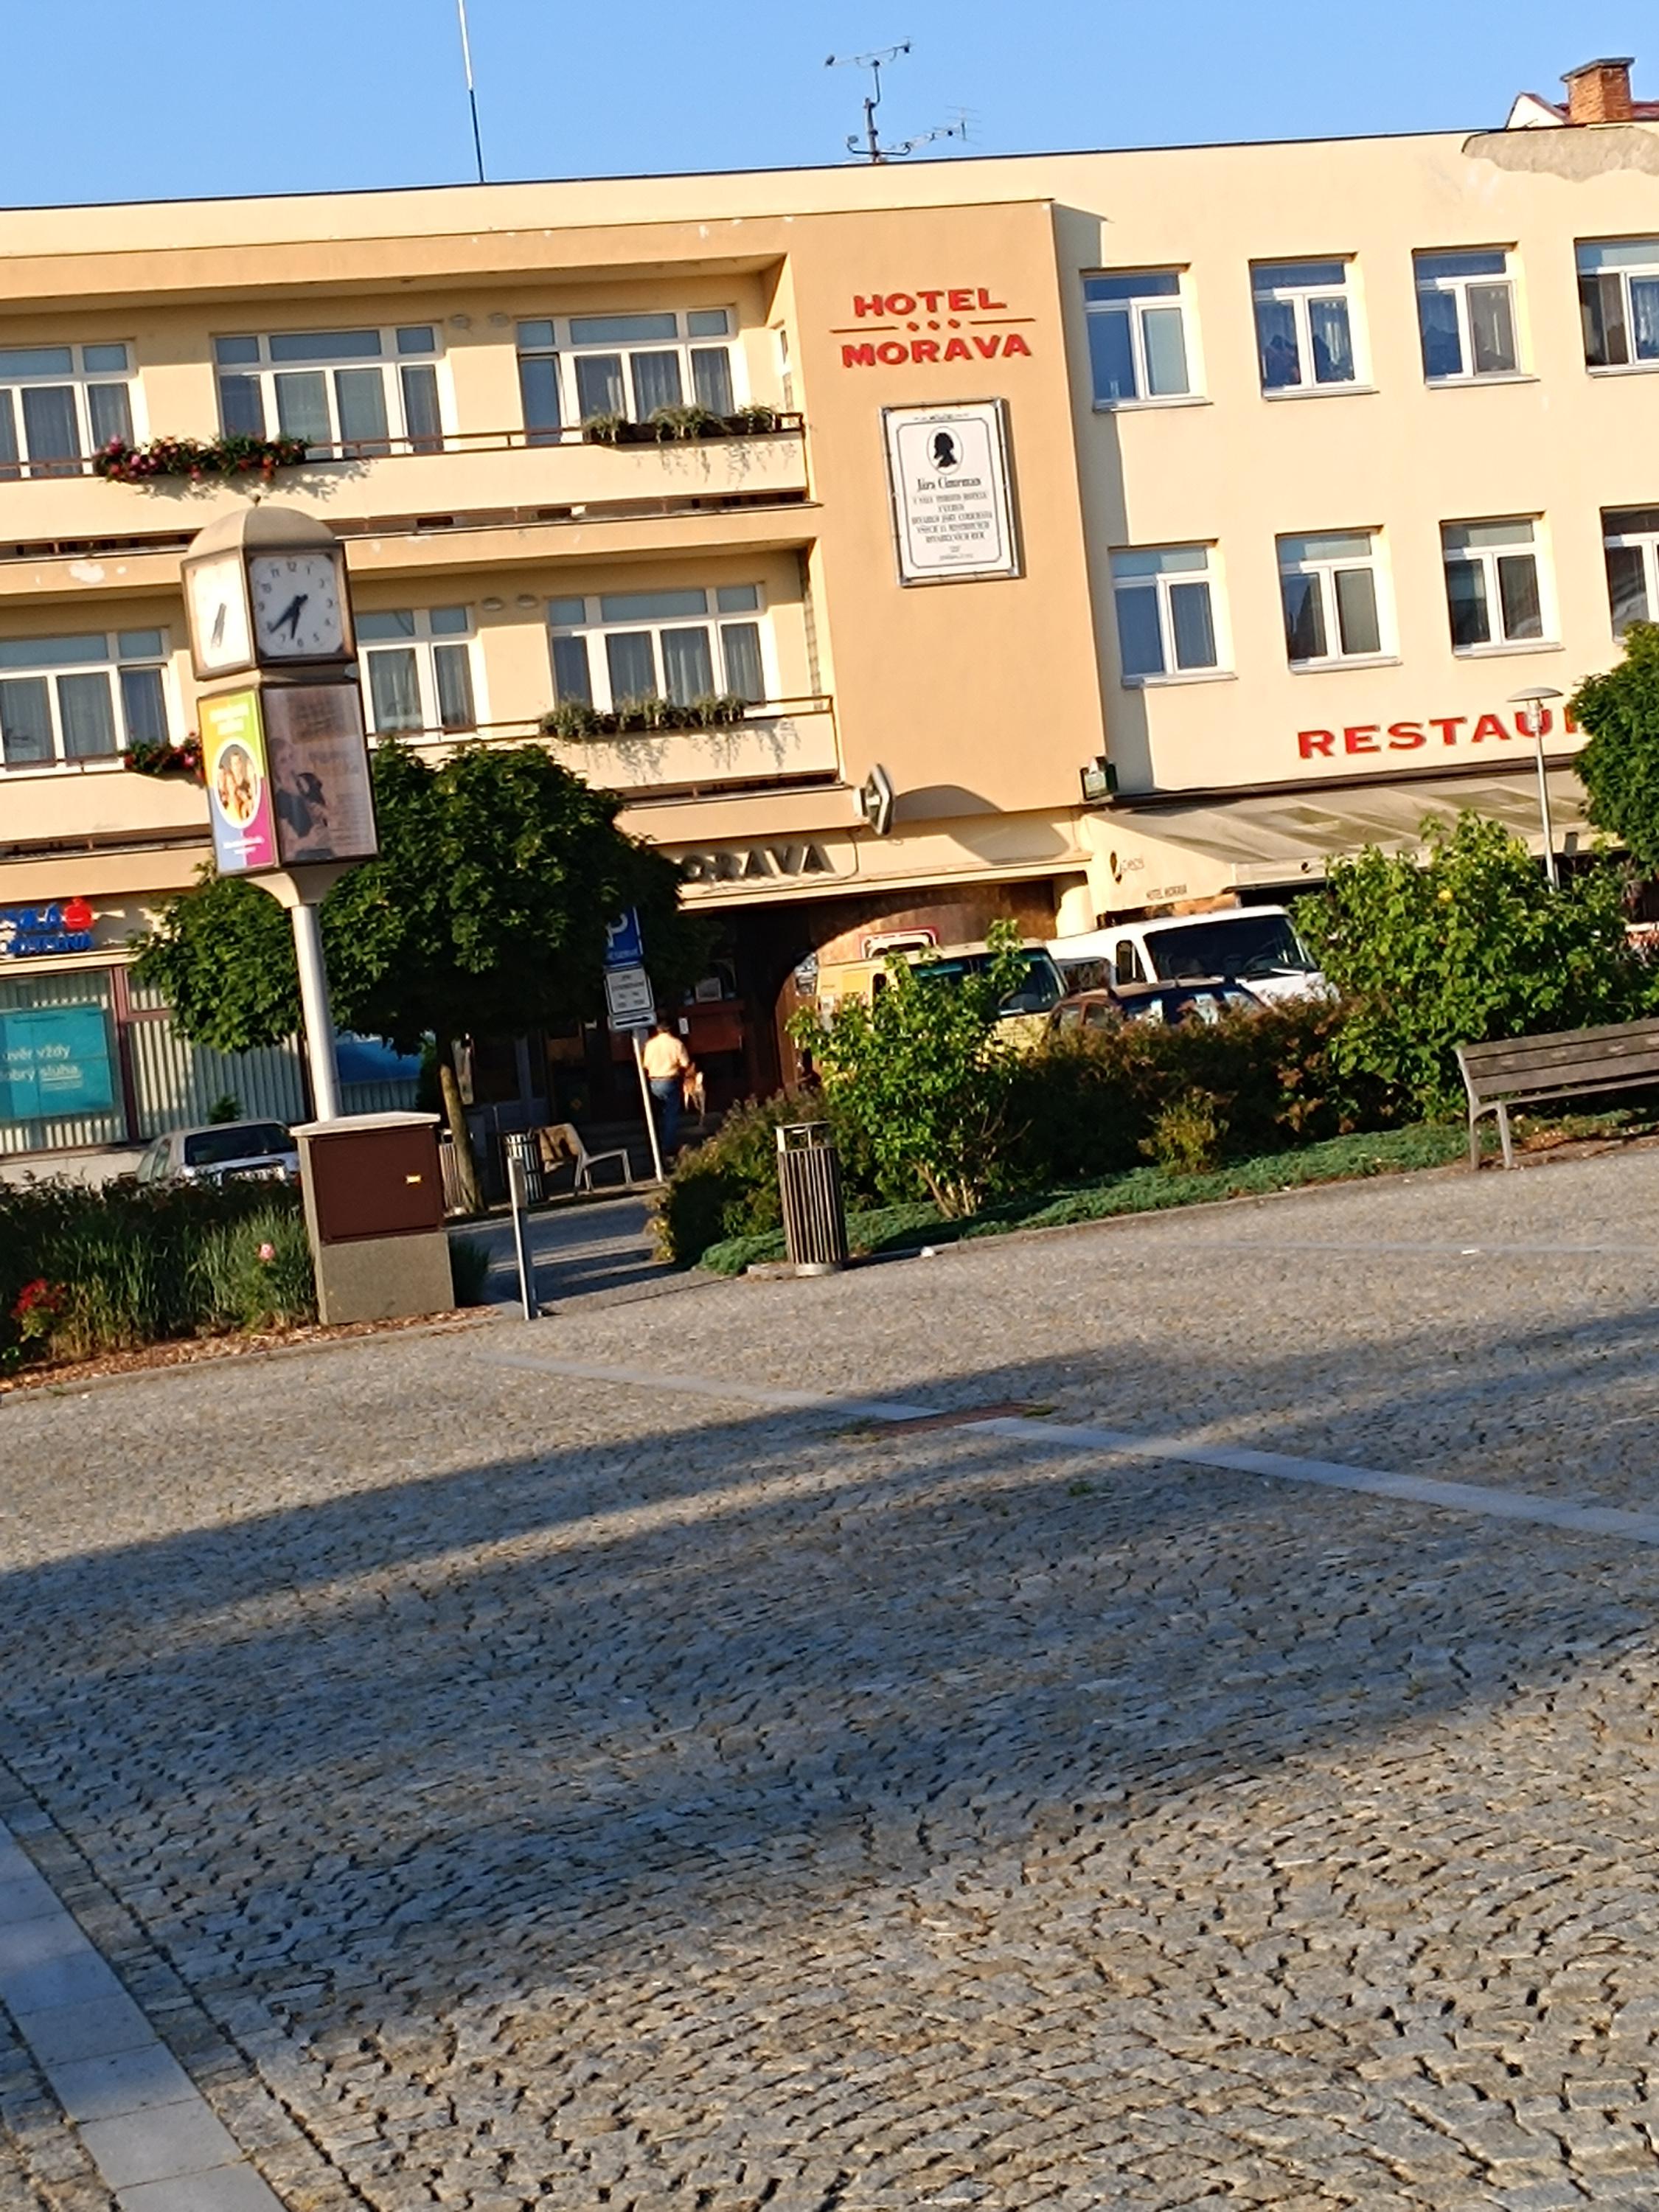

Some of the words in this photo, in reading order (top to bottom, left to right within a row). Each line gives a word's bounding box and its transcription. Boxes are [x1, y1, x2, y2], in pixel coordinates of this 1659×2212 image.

[853, 288, 1007, 317] HOTEL
[841, 334, 1032, 368] MORAVA
[680, 844, 833, 882] ORAVA
